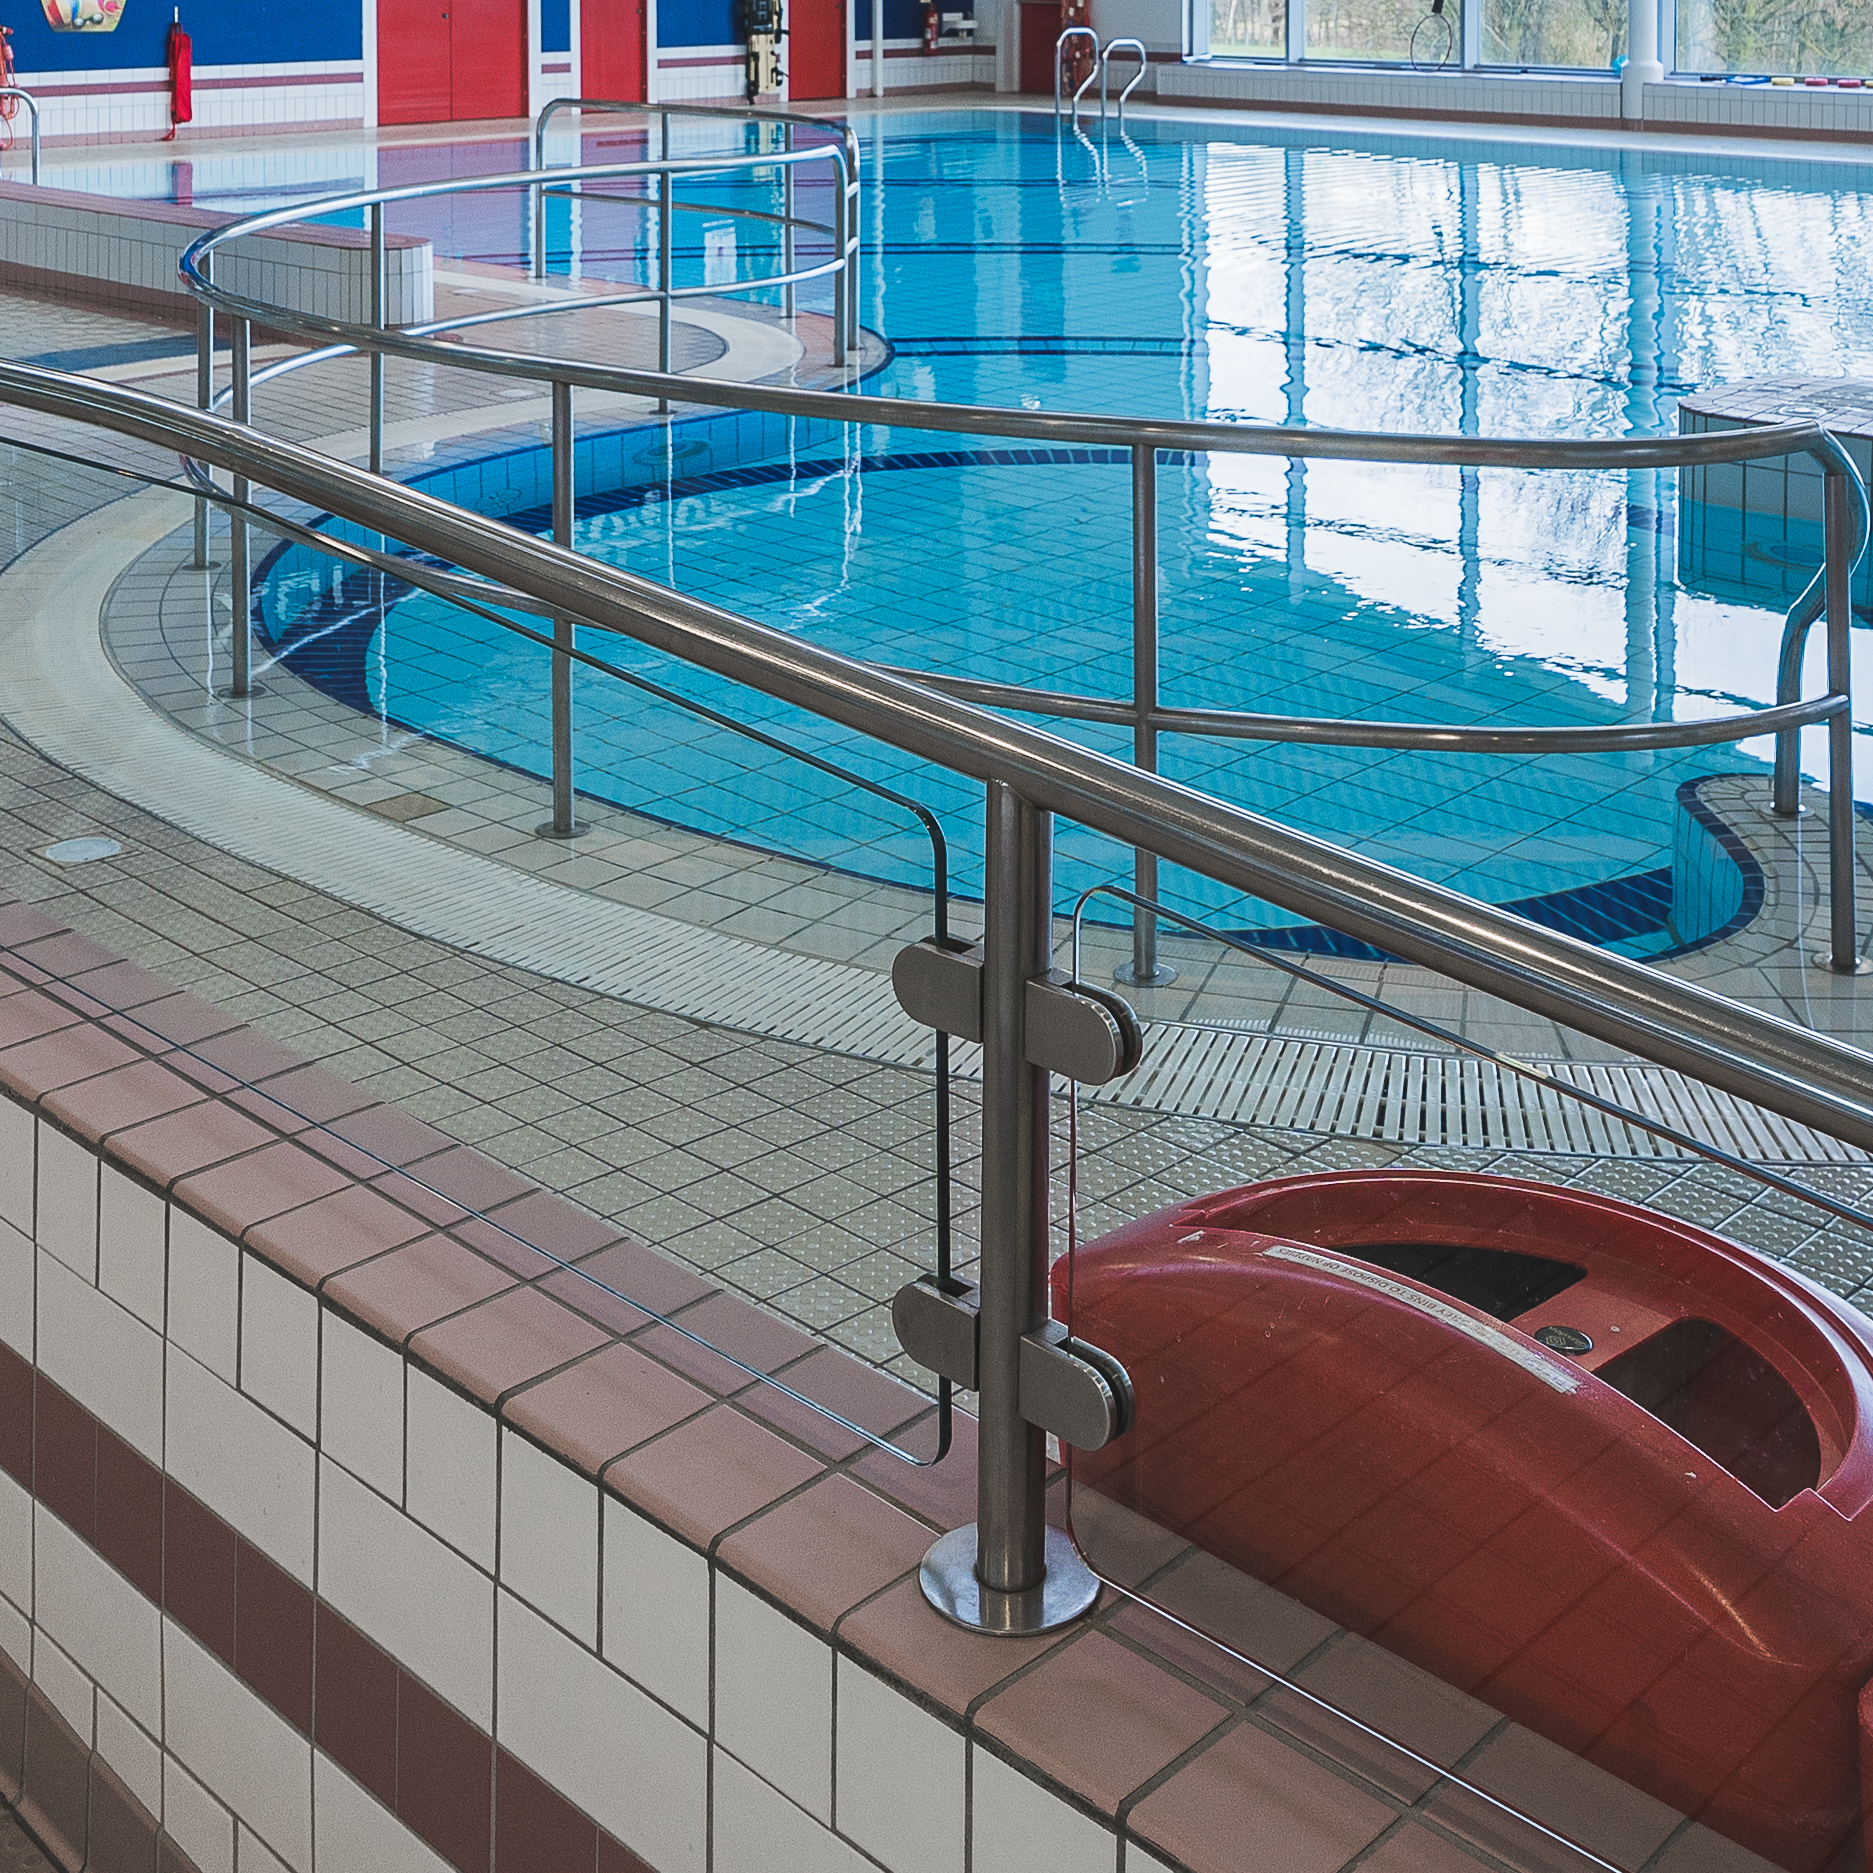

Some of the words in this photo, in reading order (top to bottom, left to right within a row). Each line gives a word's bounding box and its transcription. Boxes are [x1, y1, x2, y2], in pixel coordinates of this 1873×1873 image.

[1277, 1248, 1322, 1264] NAPPIES
[1325, 1260, 1340, 1270] OF
[1340, 1267, 1388, 1287] DISPOSE
[1389, 1285, 1406, 1296] TO
[1407, 1294, 1438, 1310] BINS
